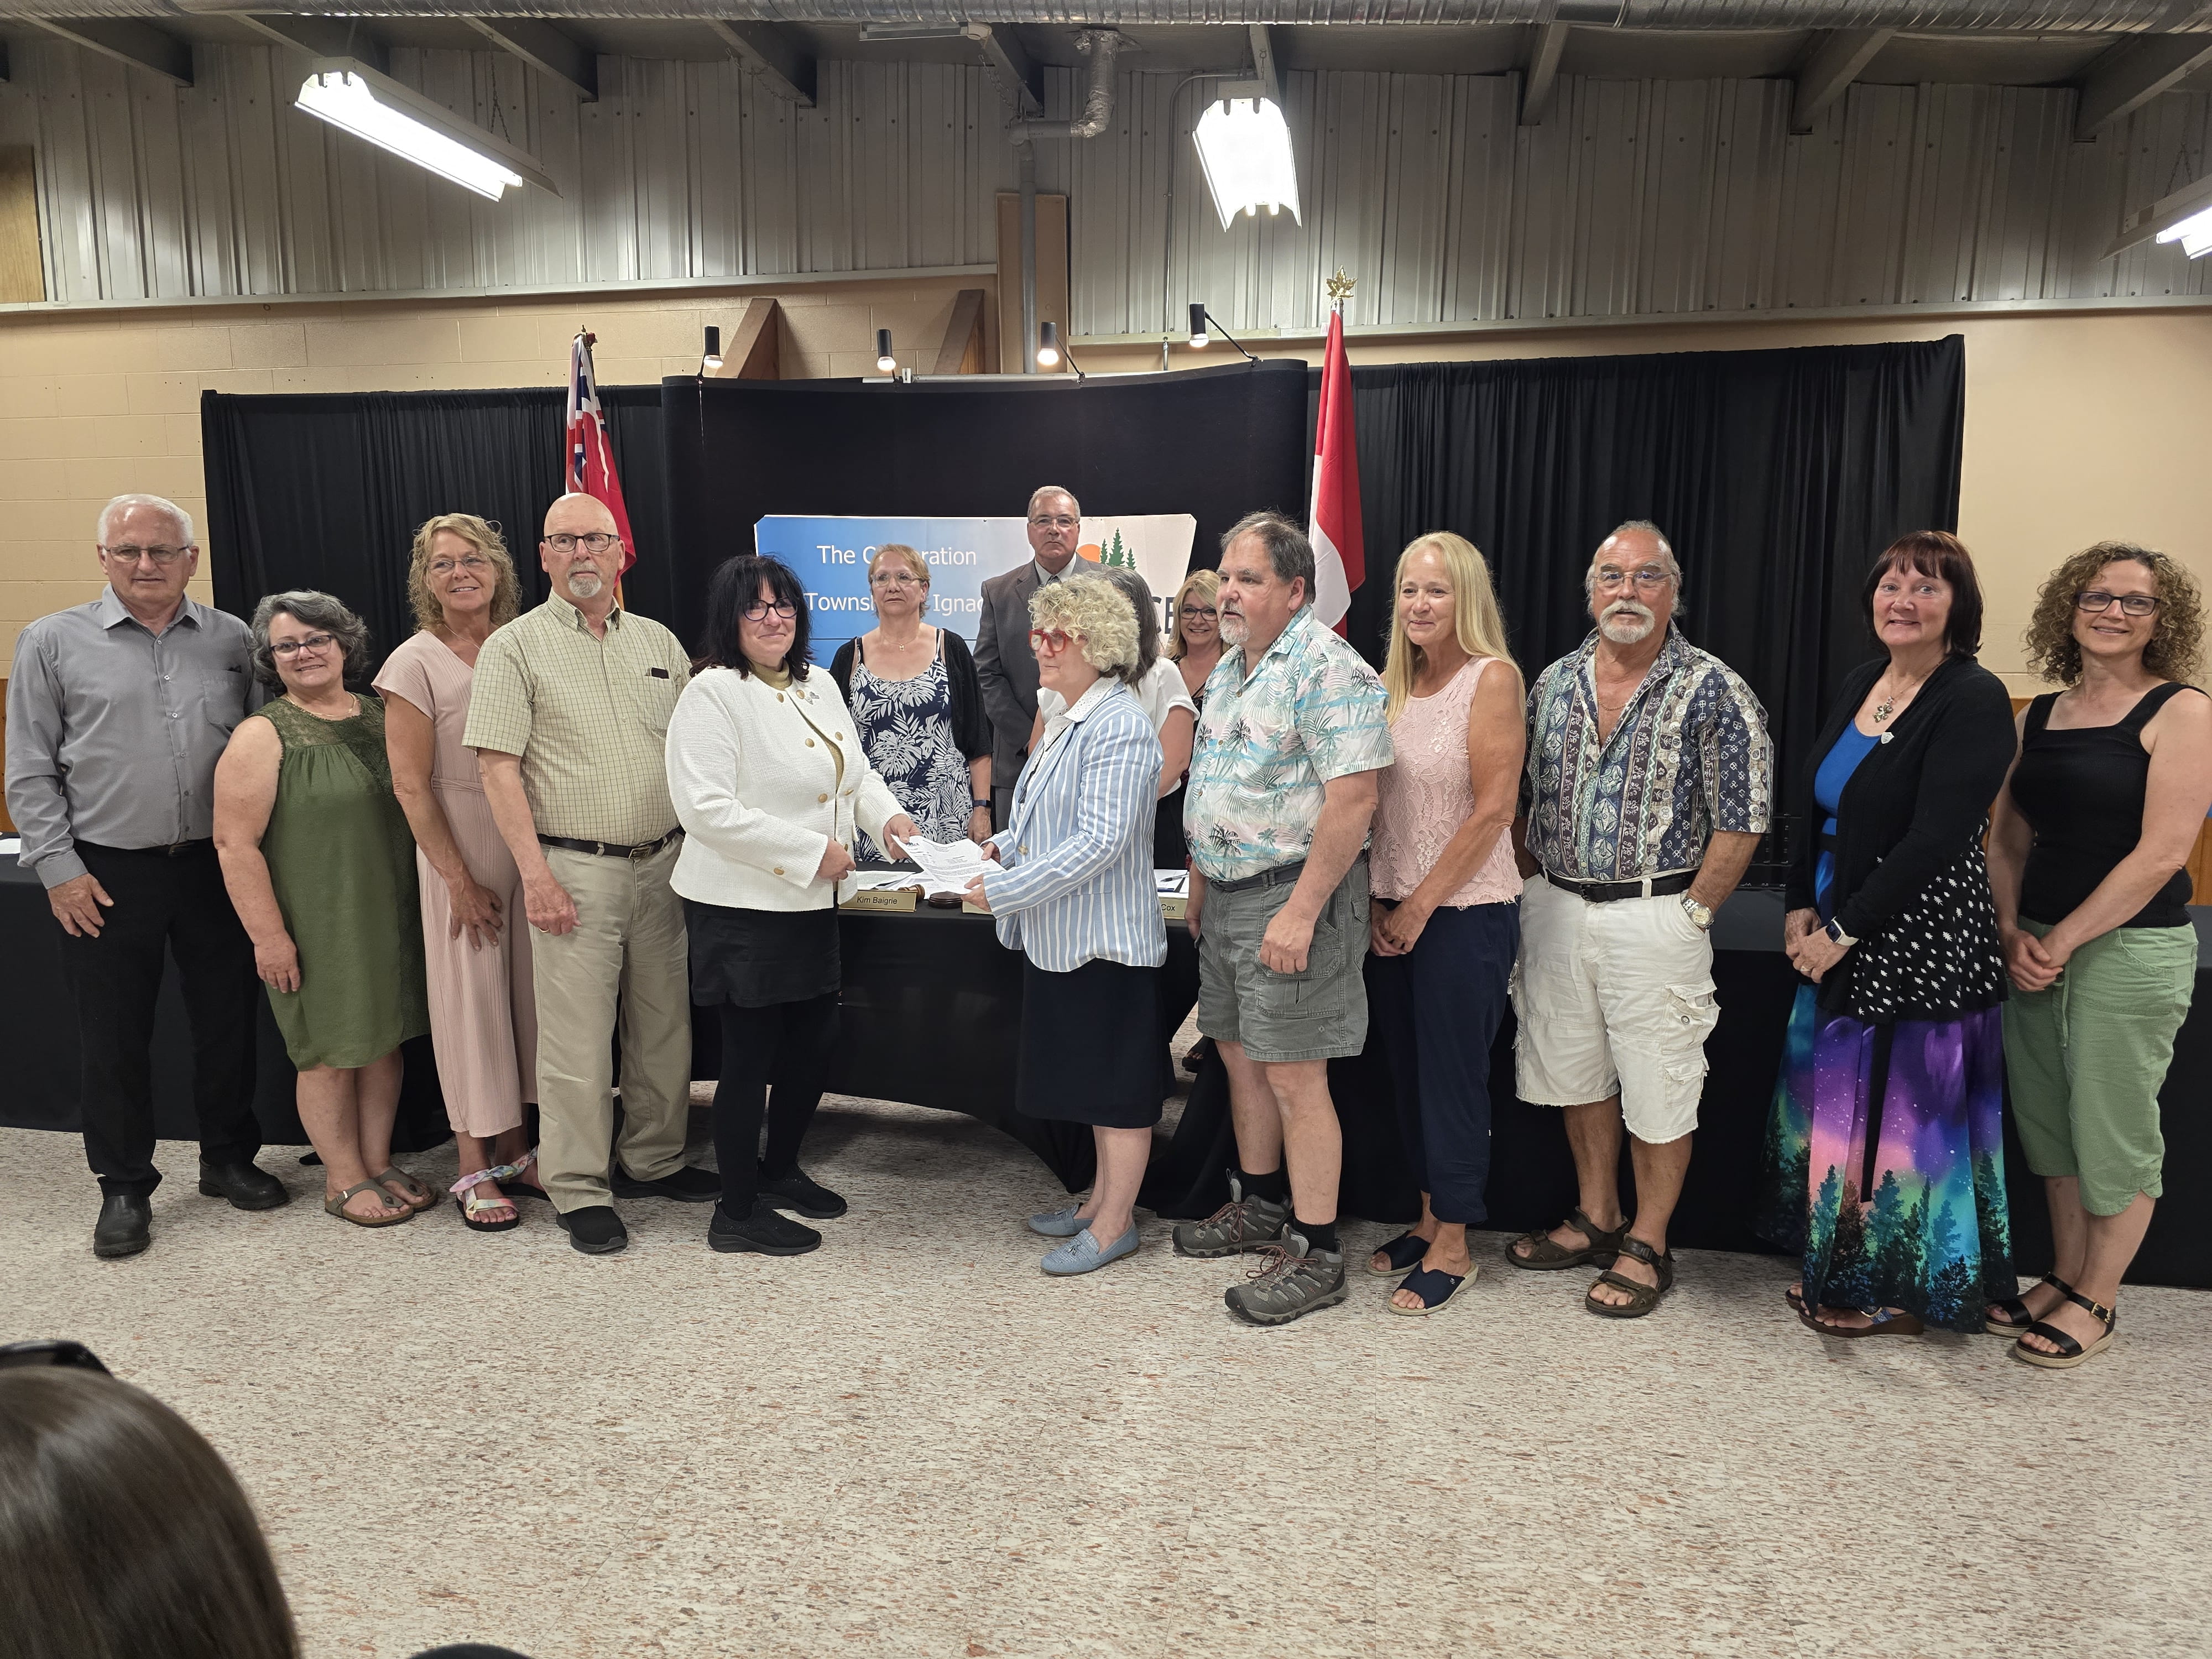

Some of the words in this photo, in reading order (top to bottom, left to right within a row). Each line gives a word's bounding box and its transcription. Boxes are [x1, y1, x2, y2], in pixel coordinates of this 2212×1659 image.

[816, 545, 856, 564] The
[862, 546, 977, 565] Cration
[803, 592, 874, 611] Towns
[933, 594, 984, 616] Ignac
[873, 896, 898, 905] Baigrie
